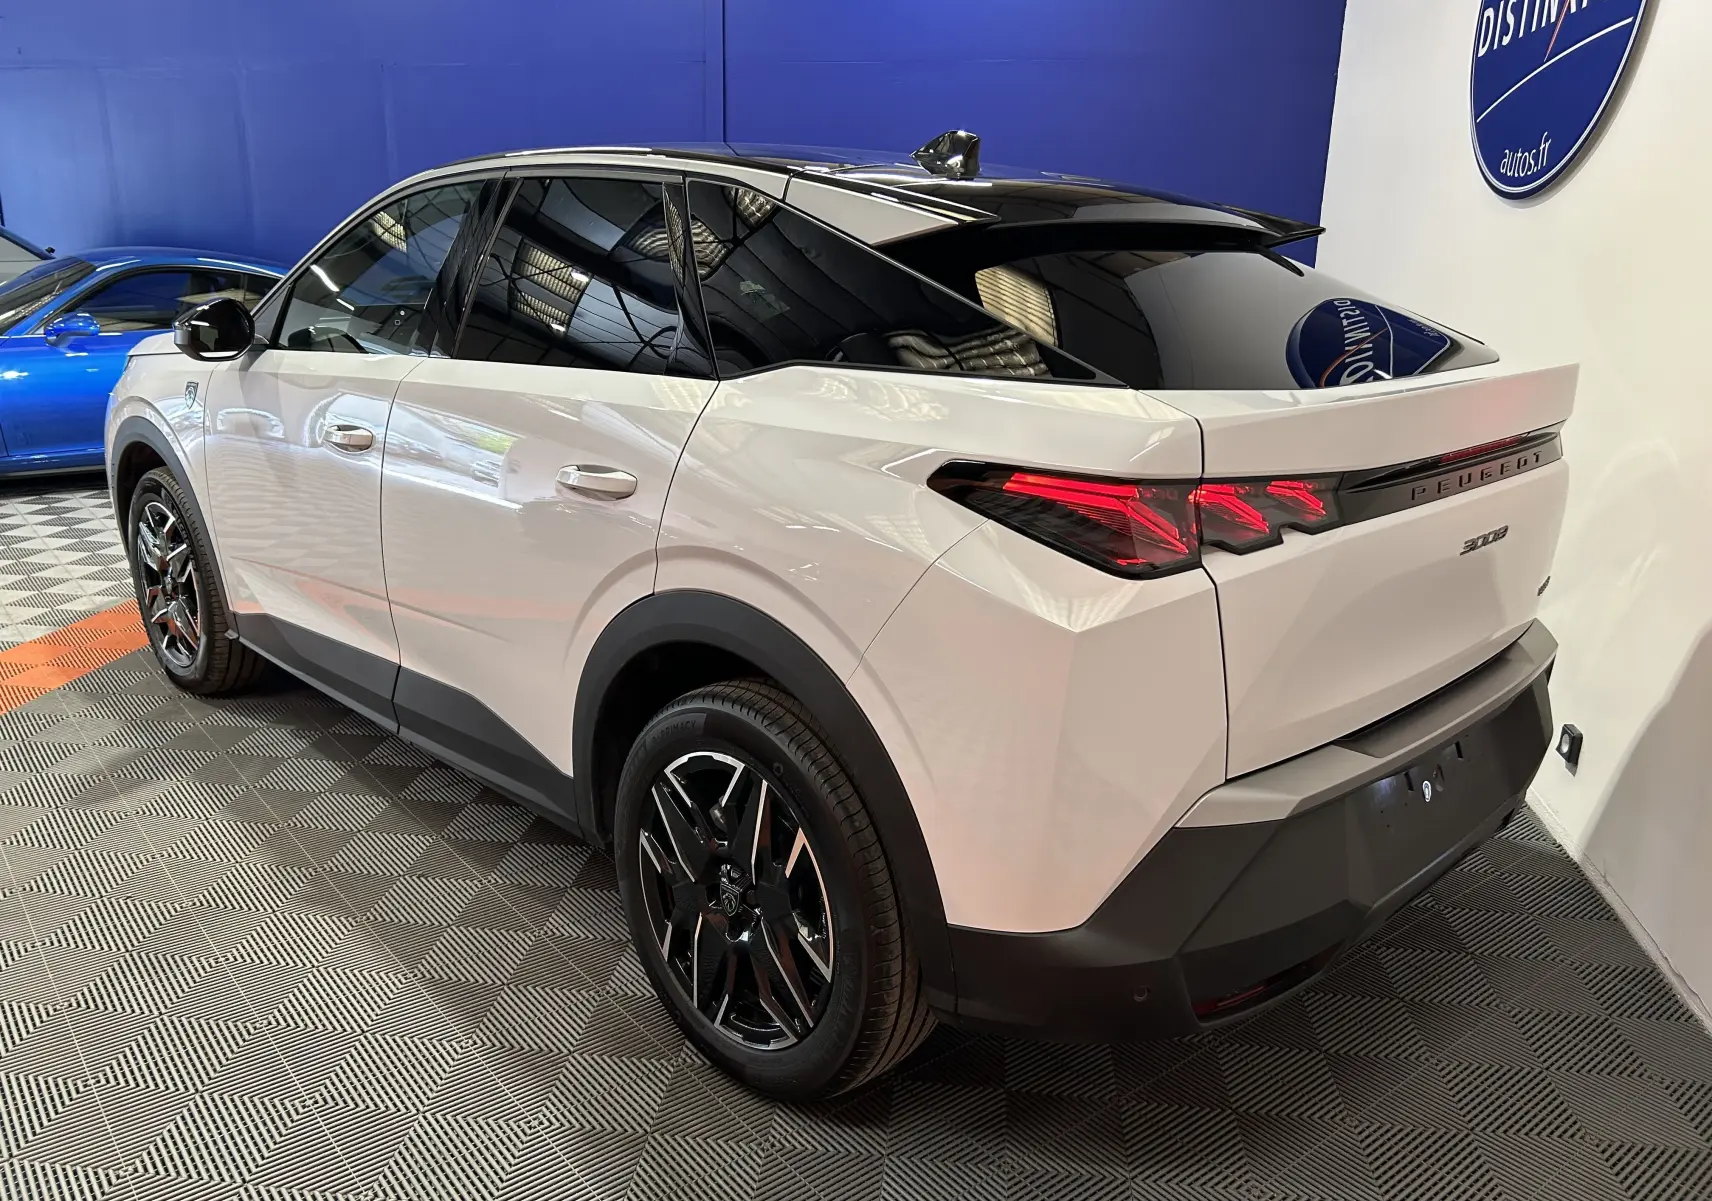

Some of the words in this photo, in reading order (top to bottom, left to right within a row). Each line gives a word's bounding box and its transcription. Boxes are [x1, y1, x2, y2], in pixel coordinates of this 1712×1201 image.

[1500, 131, 1551, 178] autos.fr
[1411, 451, 1543, 501] PEUGEOT
[1459, 525, 1509, 556] 3008
